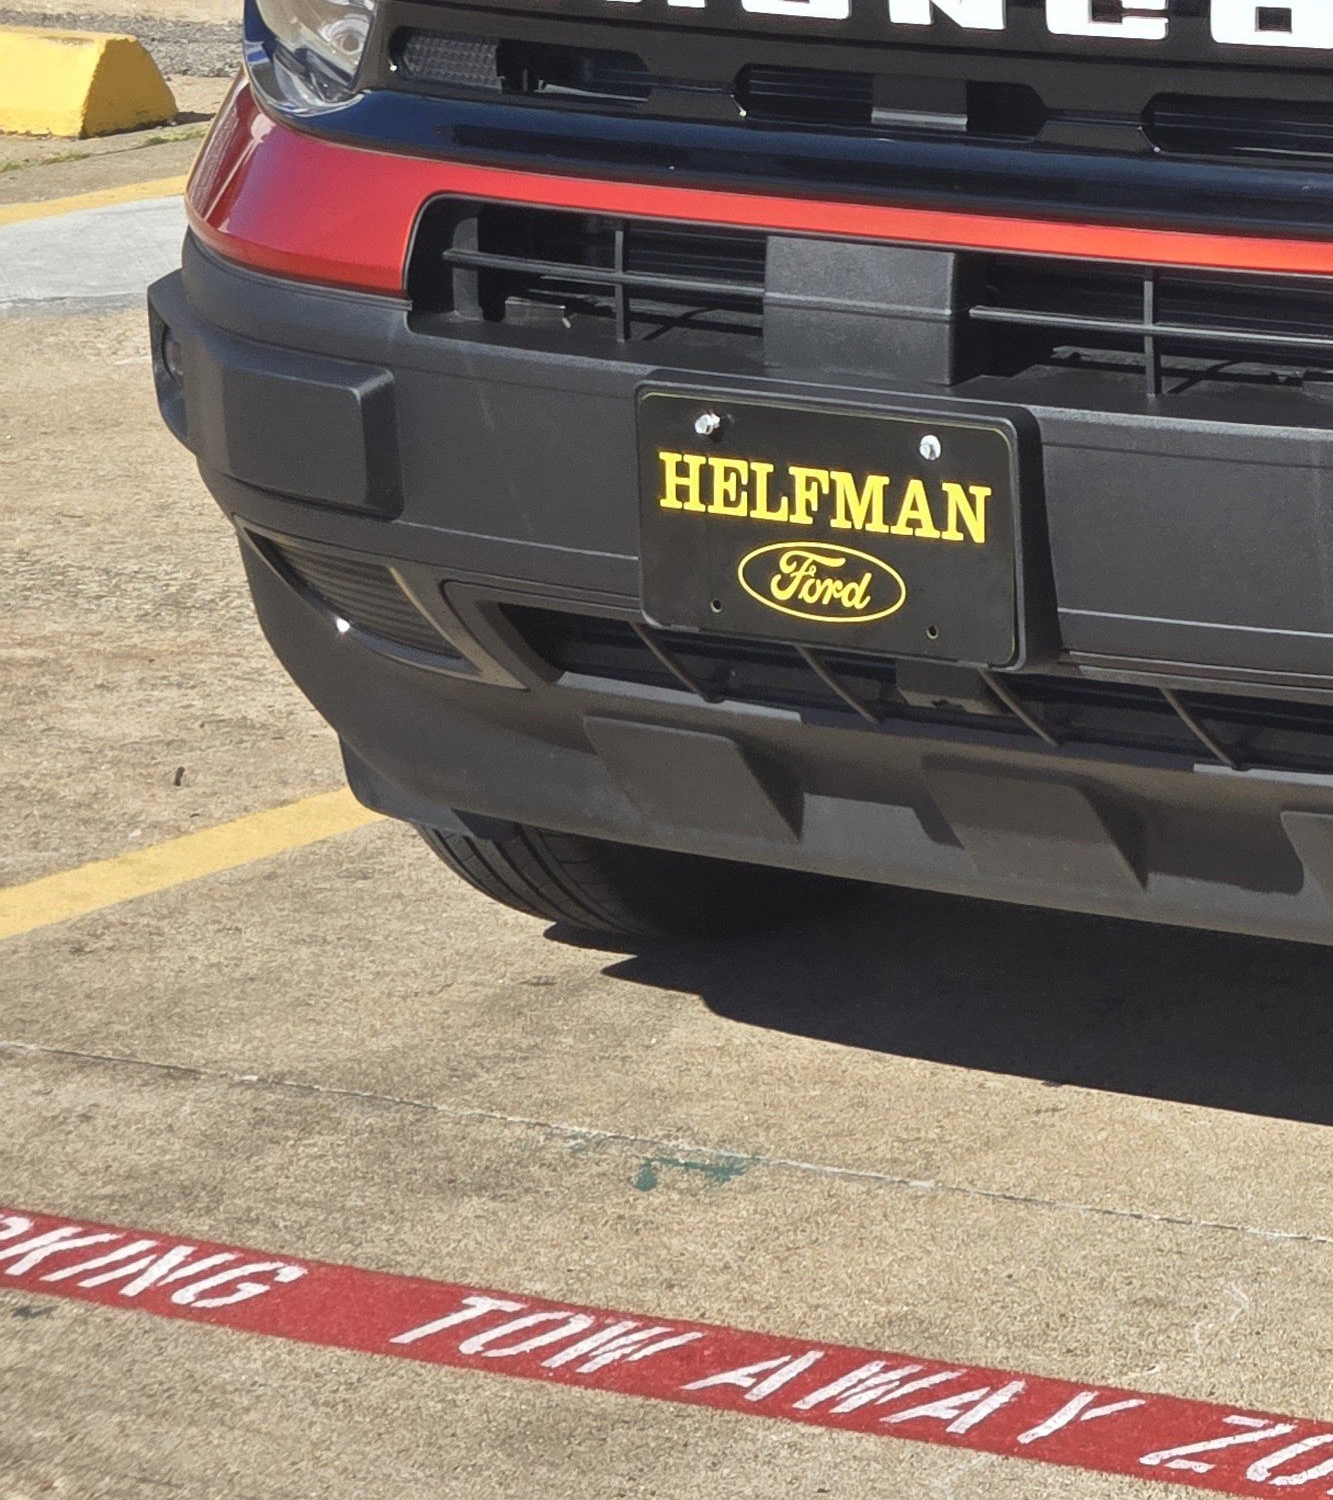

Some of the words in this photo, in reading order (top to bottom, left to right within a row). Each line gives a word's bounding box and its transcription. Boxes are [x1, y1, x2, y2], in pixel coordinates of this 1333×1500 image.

[659, 451, 992, 543] HELFMAN
[770, 550, 873, 610] Ford
[388, 1296, 703, 1373] TOW
[679, 1350, 1146, 1444] AWAY
